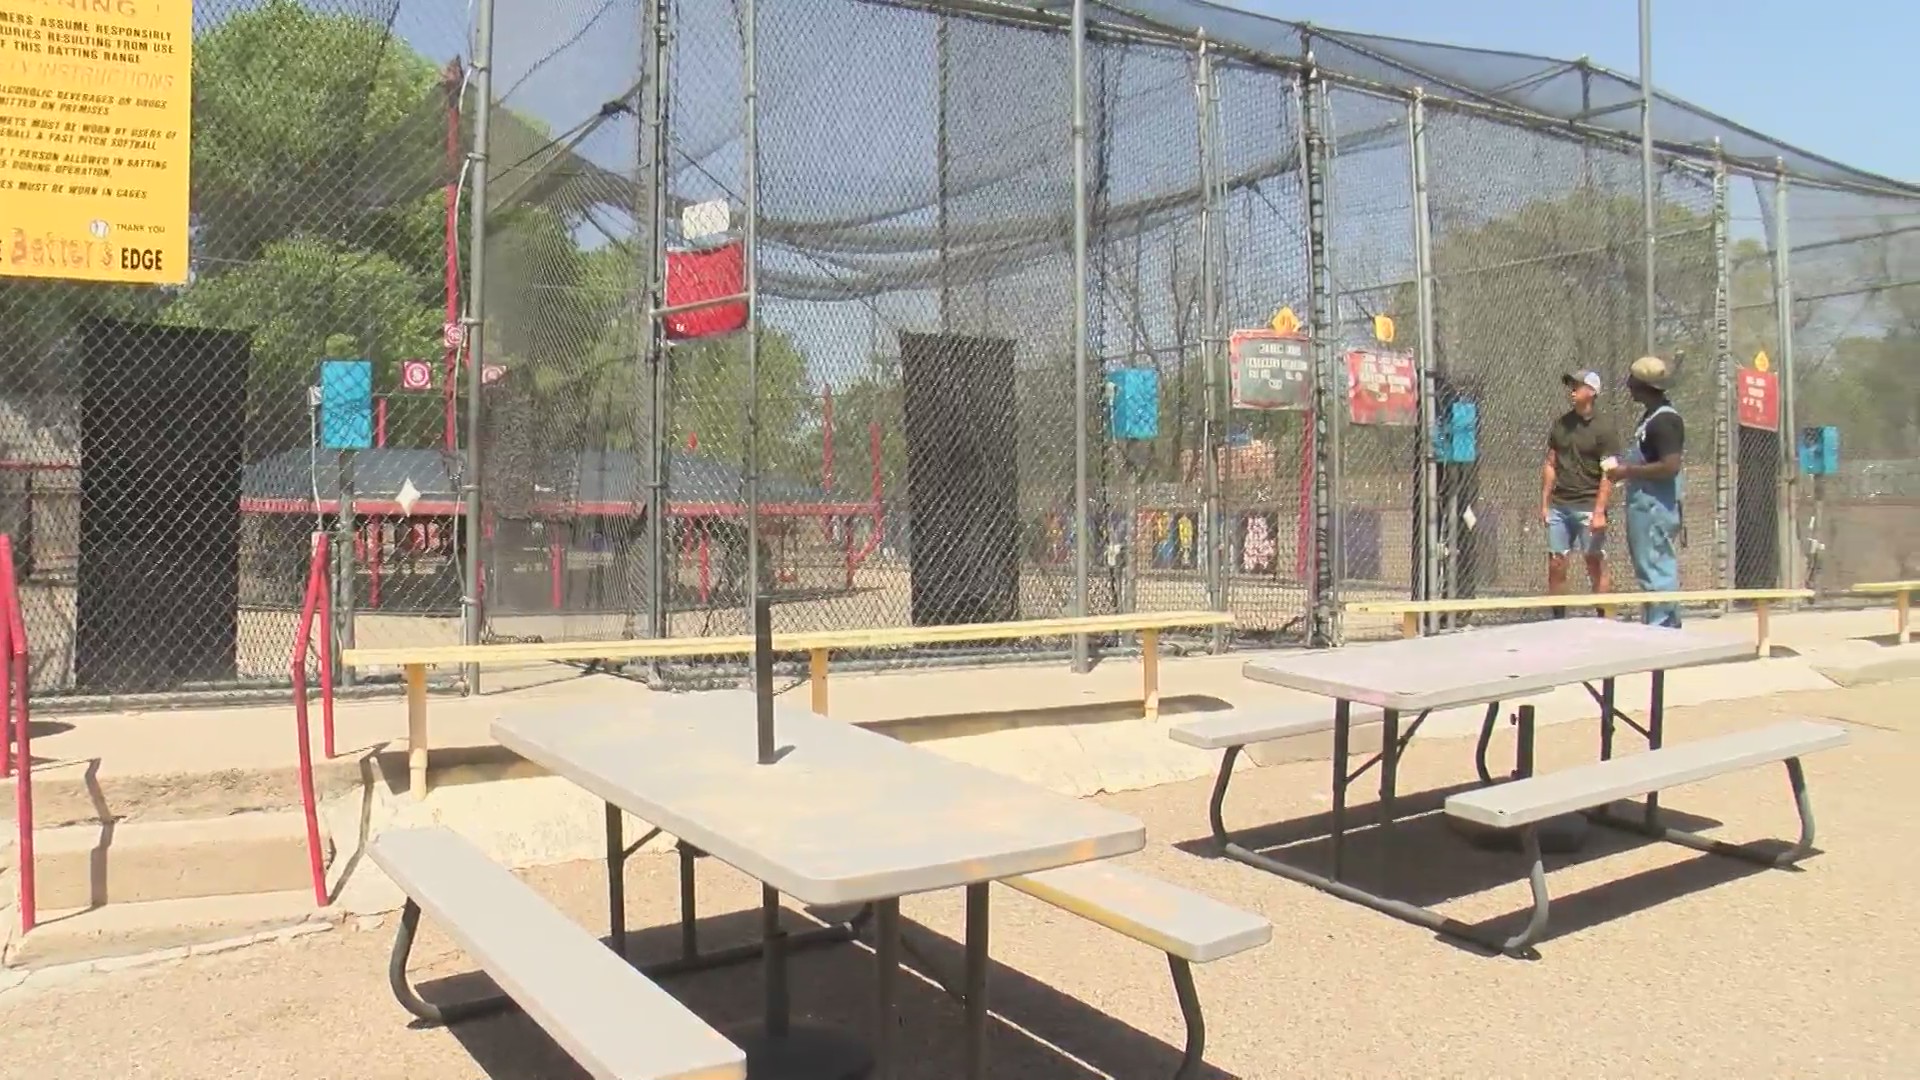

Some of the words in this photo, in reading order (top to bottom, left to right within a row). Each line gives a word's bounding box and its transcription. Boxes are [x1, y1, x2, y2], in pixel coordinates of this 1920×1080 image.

[40, 17, 89, 32] ASSUME
[47, 31, 111, 49] RESULTING
[116, 39, 148, 52] FROM
[153, 42, 174, 54] USE
[14, 40, 41, 53] THIS
[47, 44, 98, 60] BATTING
[103, 51, 140, 63] RANGE
[31, 118, 60, 129] MUST
[49, 132, 73, 144] FAST
[18, 149, 60, 161] PERSON
[12, 160, 51, 173] DURING
[18, 181, 48, 193] MUST
[116, 223, 145, 233] THANK
[148, 226, 166, 234] YOU
[121, 247, 163, 271] EDGE
